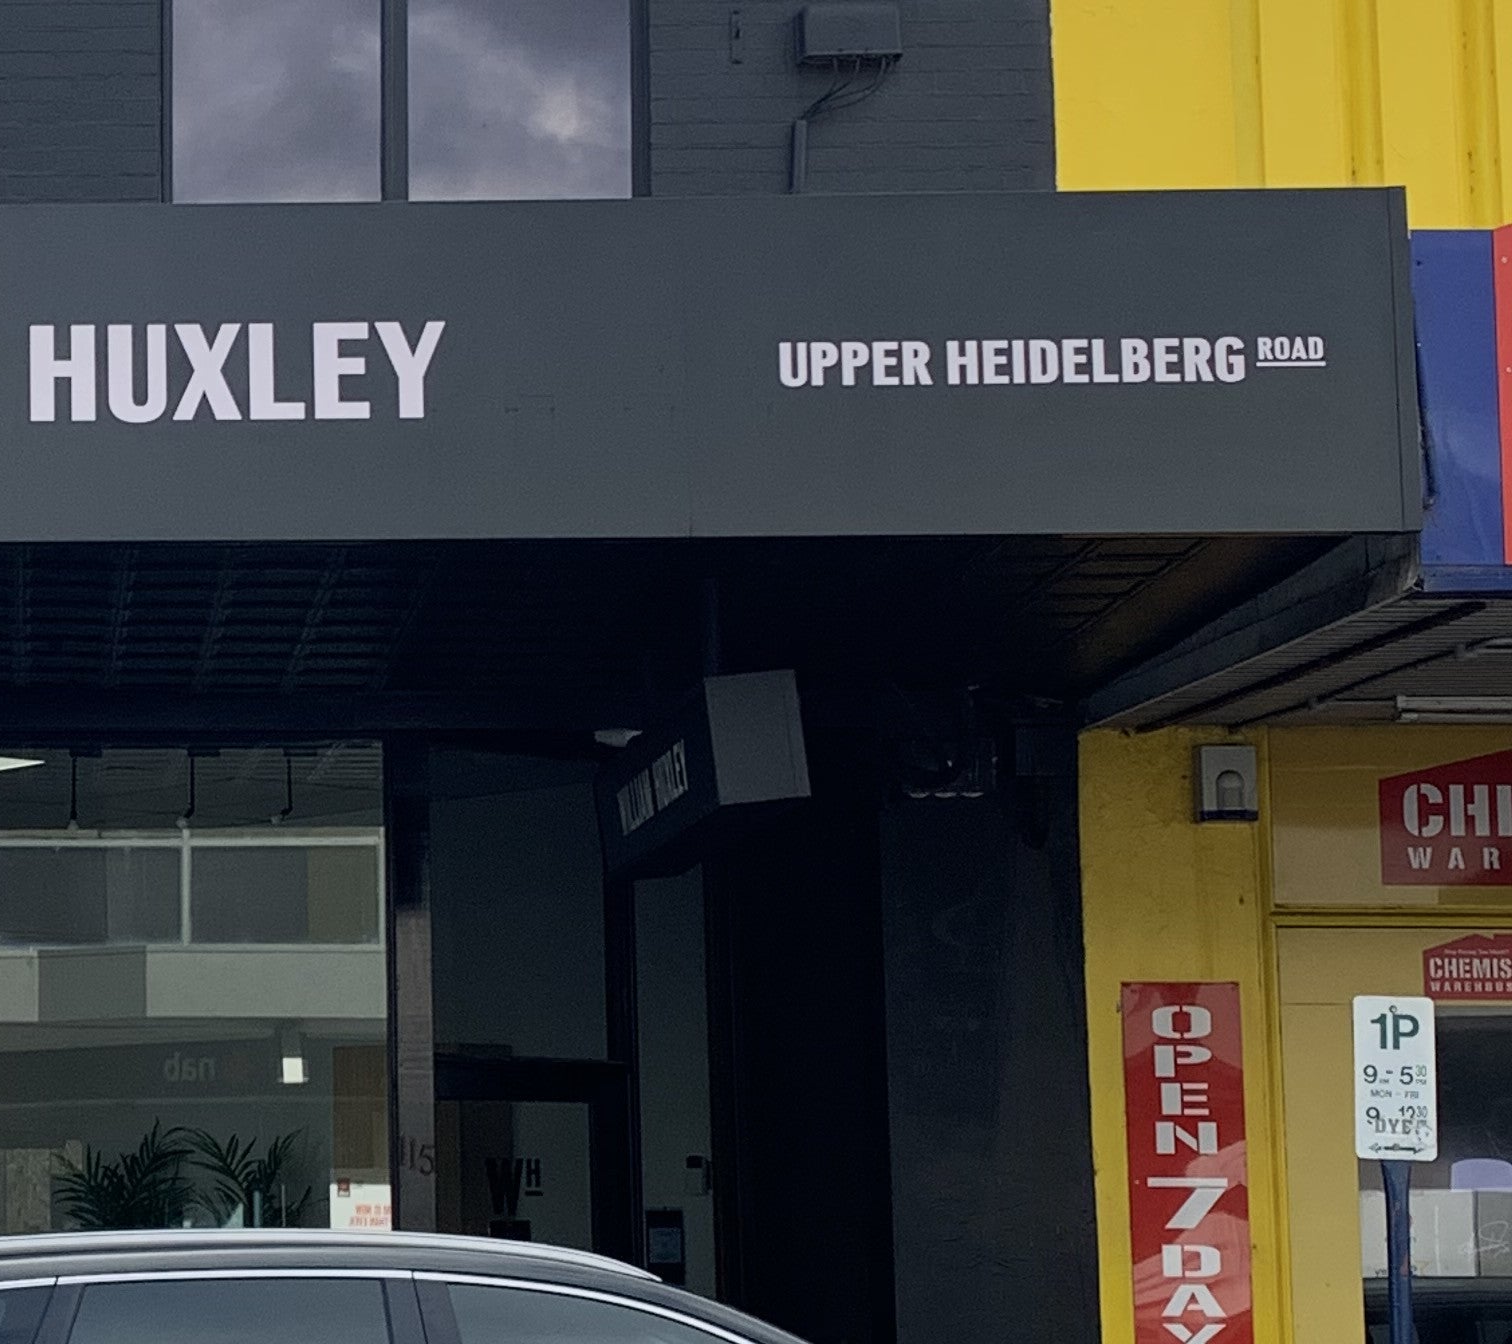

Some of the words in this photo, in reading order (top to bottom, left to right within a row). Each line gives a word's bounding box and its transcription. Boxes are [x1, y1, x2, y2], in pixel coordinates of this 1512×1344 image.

[29, 321, 446, 423] HUXLEY
[778, 341, 934, 387] UPPER
[945, 336, 1246, 385] HEIDELBERG
[1257, 336, 1325, 362] ROAD
[1370, 1012, 1420, 1050] 1P
[1151, 1004, 1218, 1155] OPEN
[1363, 1064, 1378, 1084] 9
[1147, 1177, 1228, 1229] 7
